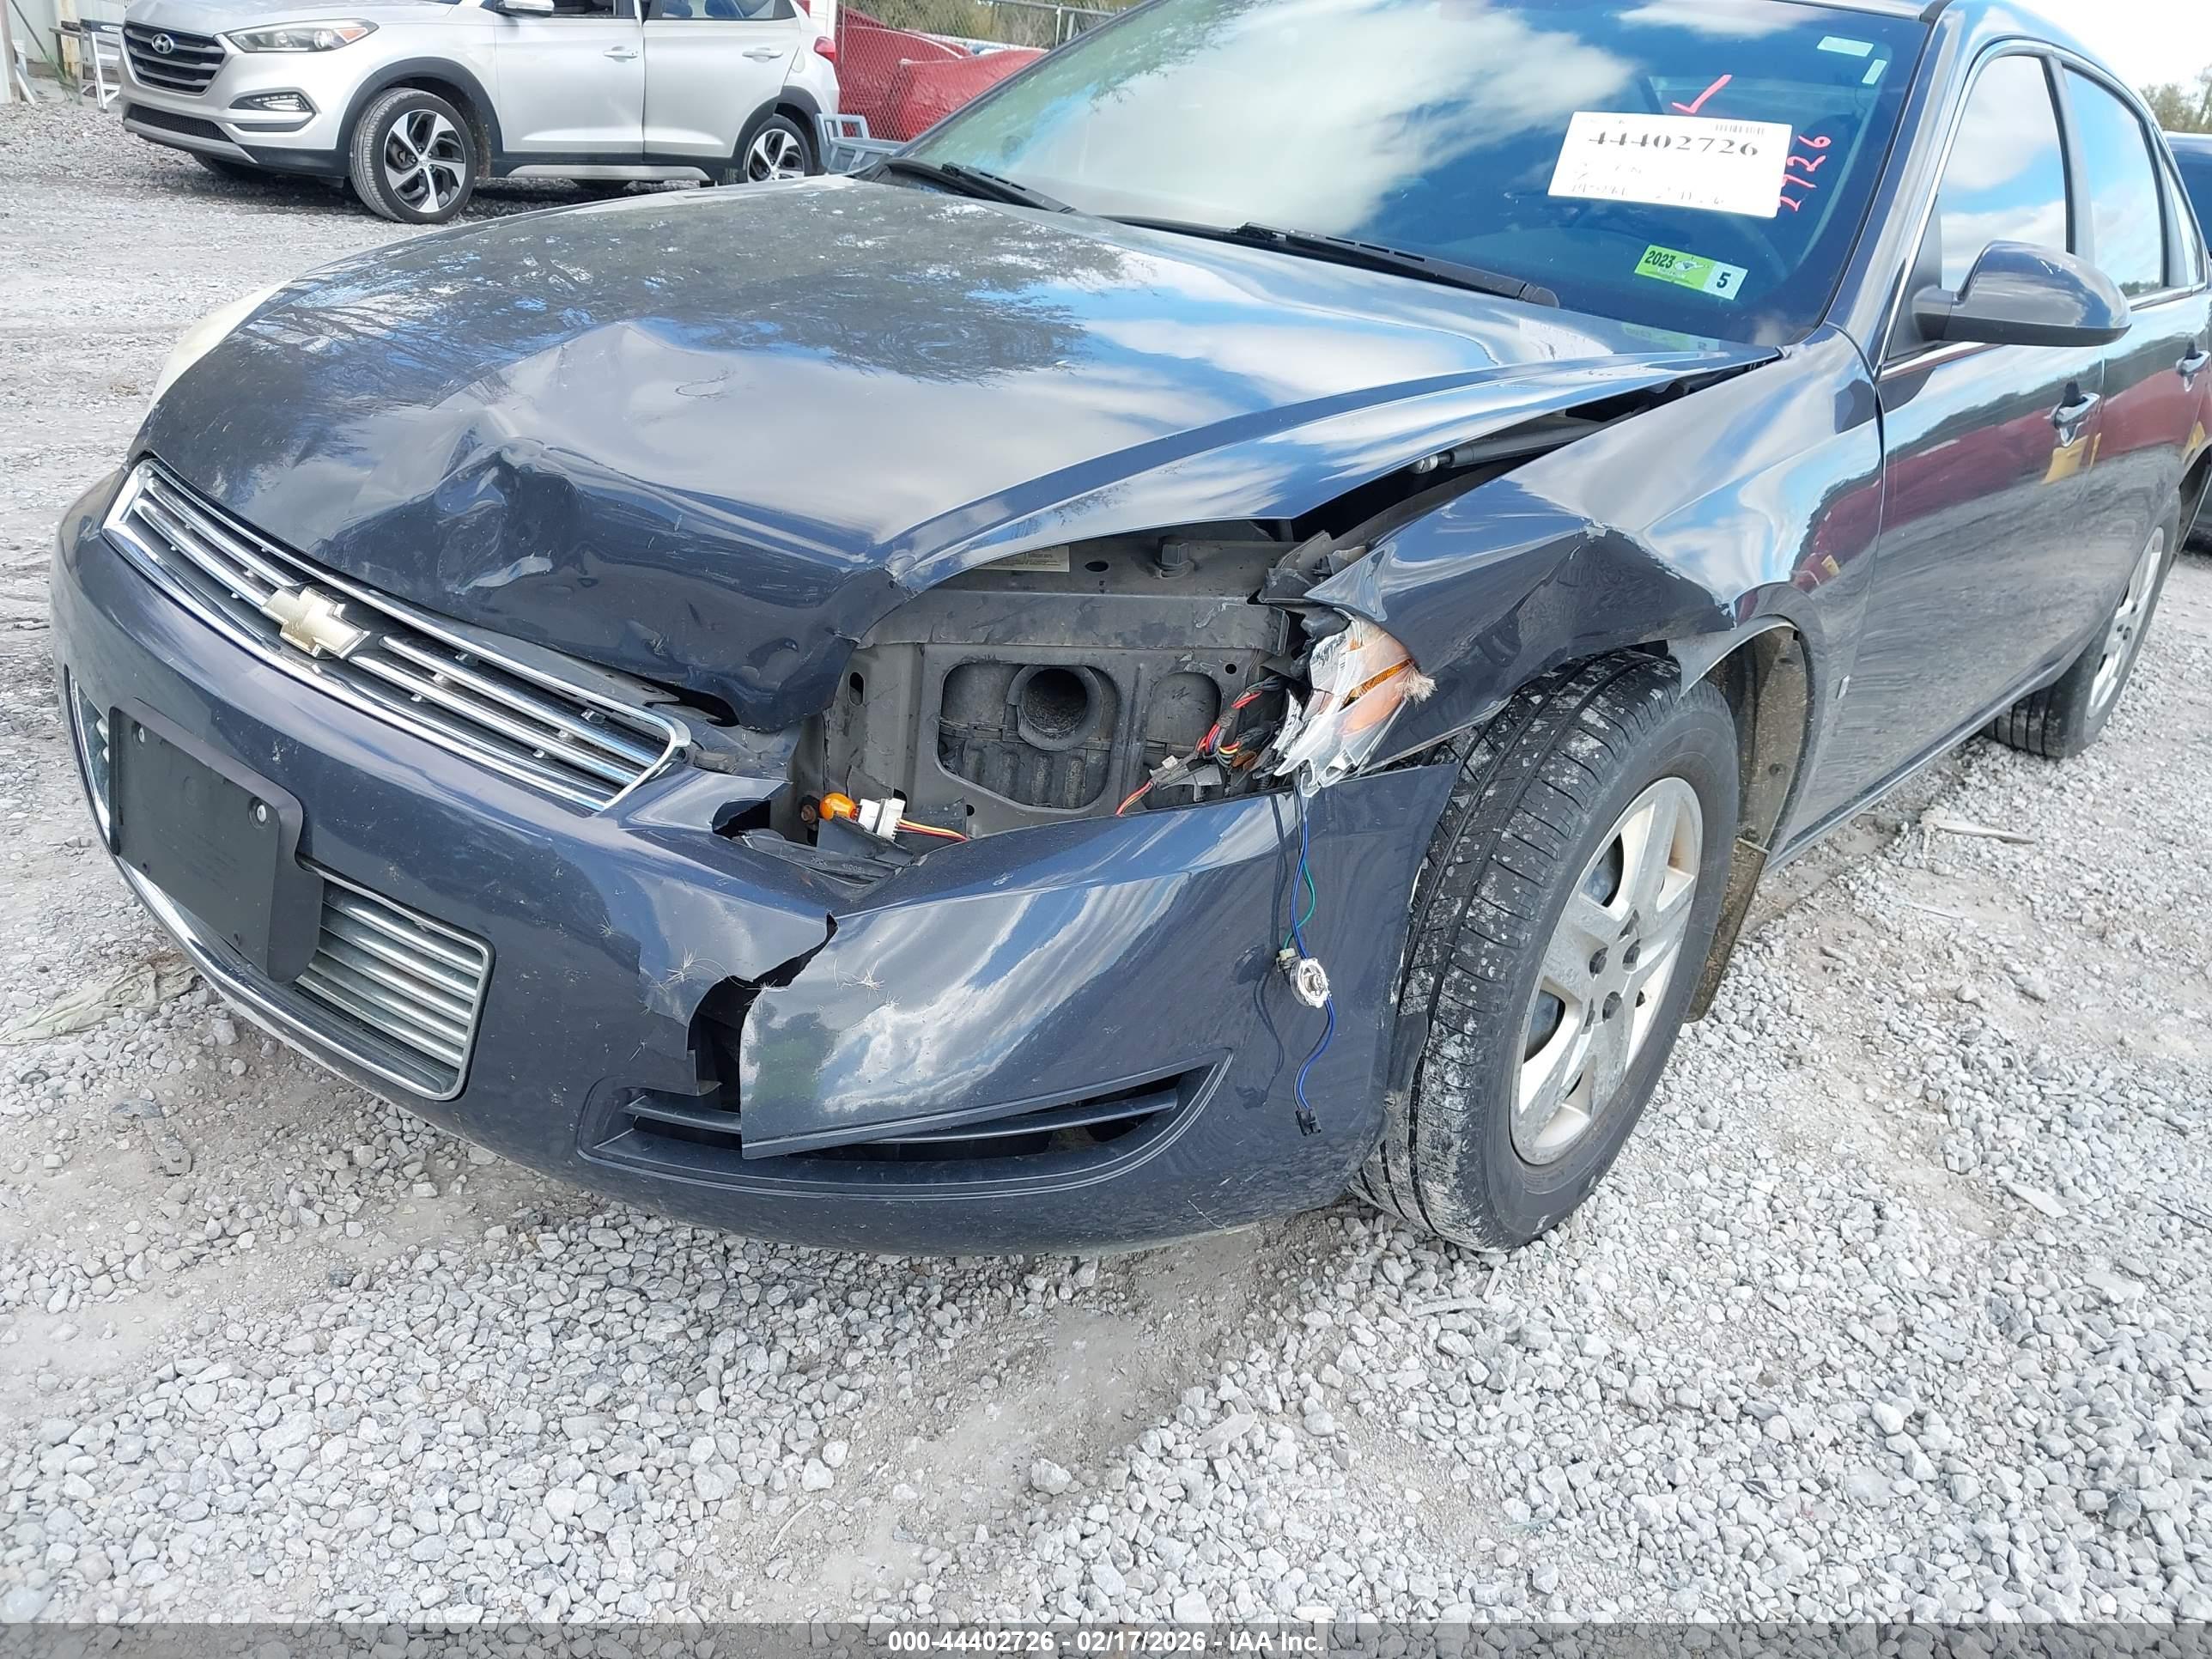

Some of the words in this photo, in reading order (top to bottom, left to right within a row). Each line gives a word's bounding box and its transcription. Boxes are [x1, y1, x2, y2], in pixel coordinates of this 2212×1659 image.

[1588, 131, 1759, 157] 44402726
[1644, 250, 1676, 269] 2023
[1716, 270, 1732, 289] 5
